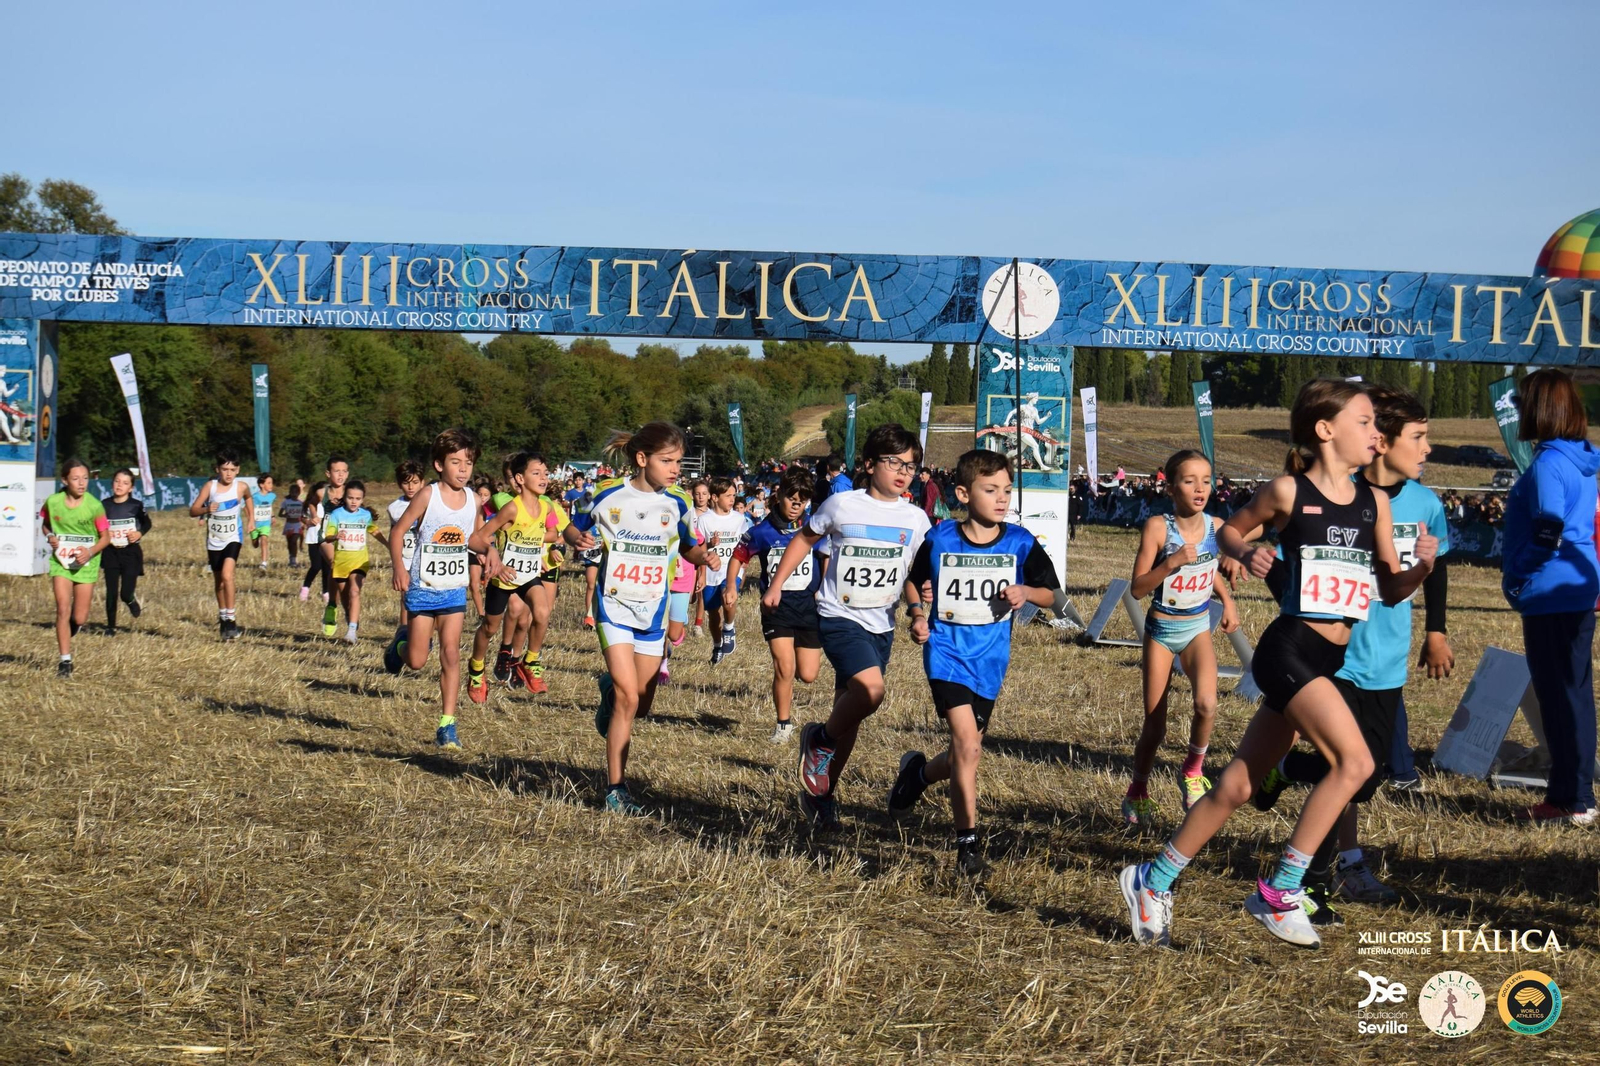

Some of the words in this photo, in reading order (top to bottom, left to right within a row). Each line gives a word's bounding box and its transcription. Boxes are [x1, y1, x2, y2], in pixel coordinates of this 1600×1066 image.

[71, 262, 91, 275] DE
[94, 261, 184, 277] ANDALUCÍA
[0, 274, 18, 287] DE
[20, 275, 76, 288] CAMPO
[78, 276, 90, 288] A
[93, 274, 150, 289] TRAVÉS
[244, 252, 402, 307] XLIII
[406, 257, 529, 288] CROSS
[586, 248, 887, 323] ITÁLICA
[32, 289, 62, 301] POR
[64, 289, 119, 302] CLUBES
[407, 291, 574, 310] INTERNACIONAL
[1103, 273, 1263, 329] XLIII
[1267, 279, 1392, 314] CROSS
[243, 308, 392, 326] INTERNATIONAL
[397, 311, 452, 328] CROSS
[456, 312, 544, 329] COUNTRY
[1267, 314, 1436, 336] INTERNACIONAL
[1102, 329, 1254, 349] INTERNATIONAL
[1257, 334, 1313, 351] CROSS
[1317, 336, 1406, 355] COUNTRY
[1027, 362, 1060, 373] Sevilla
[210, 523, 236, 533] 4210
[616, 528, 661, 541] Chipiona
[629, 544, 658, 554] ITÁLICA
[858, 547, 890, 557] ITÁLICA
[425, 560, 465, 576] 4305
[506, 558, 539, 573] 4134
[770, 561, 810, 576] 416
[962, 556, 998, 566] ITÁLICA
[612, 563, 663, 585] 4453
[843, 566, 898, 587] 4324
[1170, 567, 1214, 593] 4421
[946, 578, 1010, 601] 4100
[1302, 574, 1370, 611] 4375
